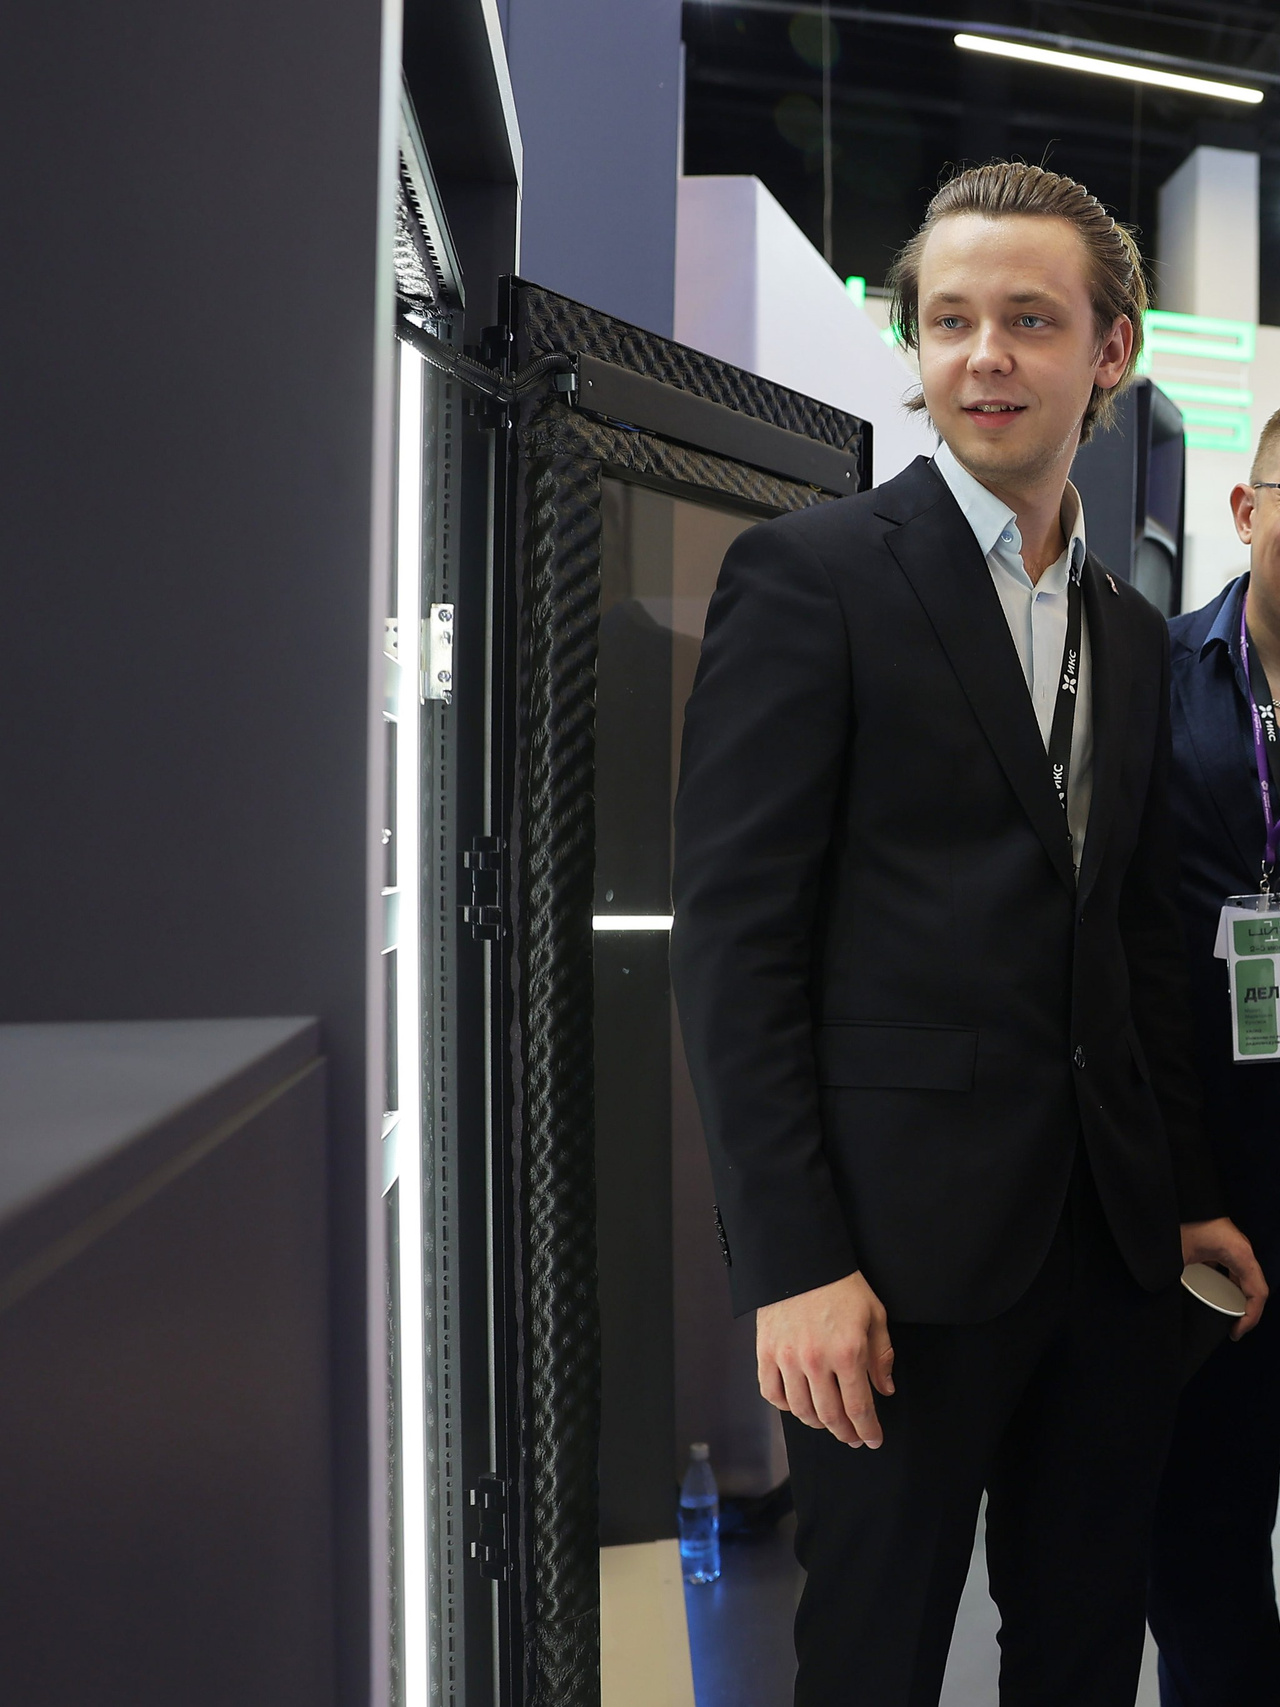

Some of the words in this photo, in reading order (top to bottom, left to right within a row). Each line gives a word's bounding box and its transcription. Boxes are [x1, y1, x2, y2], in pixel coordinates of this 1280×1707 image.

[1067, 649, 1077, 675] ИКС
[1265, 720, 1277, 742] ИКС
[1053, 763, 1064, 790] ИКС
